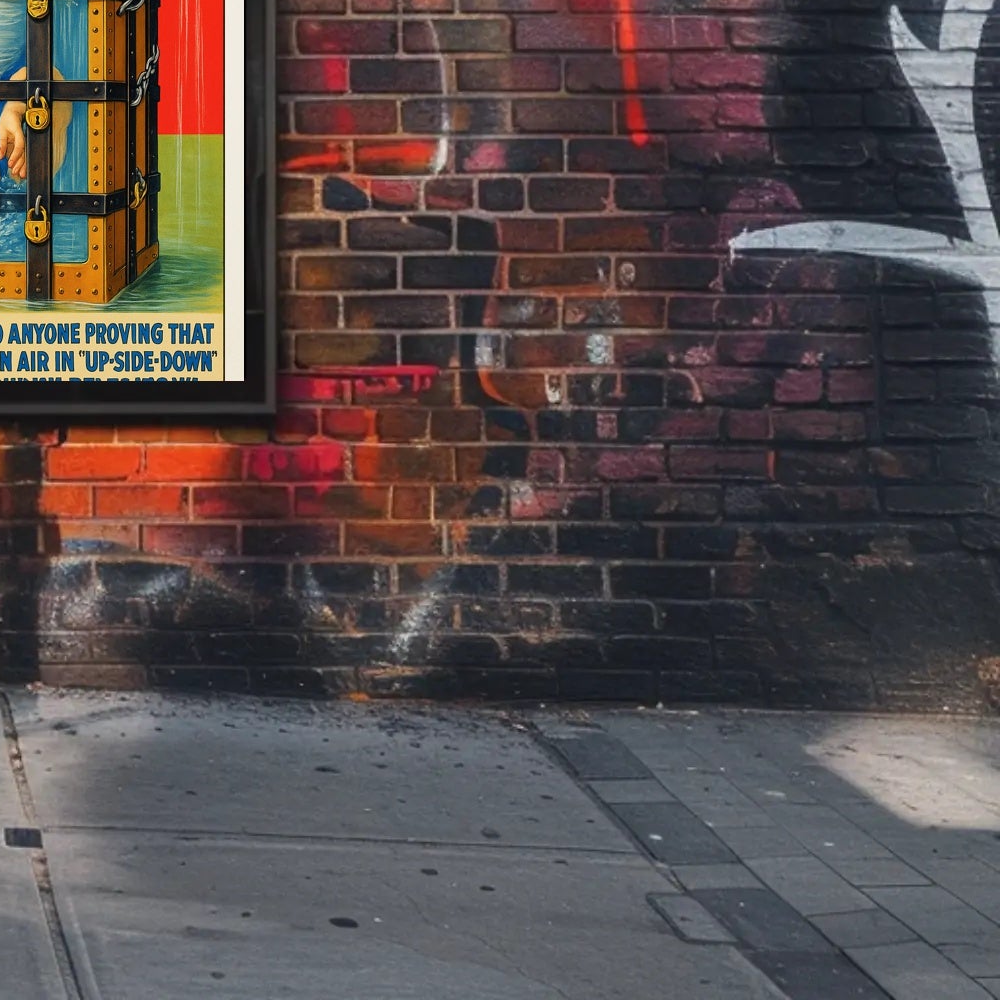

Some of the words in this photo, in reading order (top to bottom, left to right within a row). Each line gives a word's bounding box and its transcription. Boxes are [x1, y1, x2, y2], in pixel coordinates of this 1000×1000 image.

[8, 322, 81, 345] ANYONE
[85, 322, 164, 345] PROVING
[168, 322, 215, 345] THAT
[17, 350, 51, 373] AIR
[55, 350, 75, 373] IN
